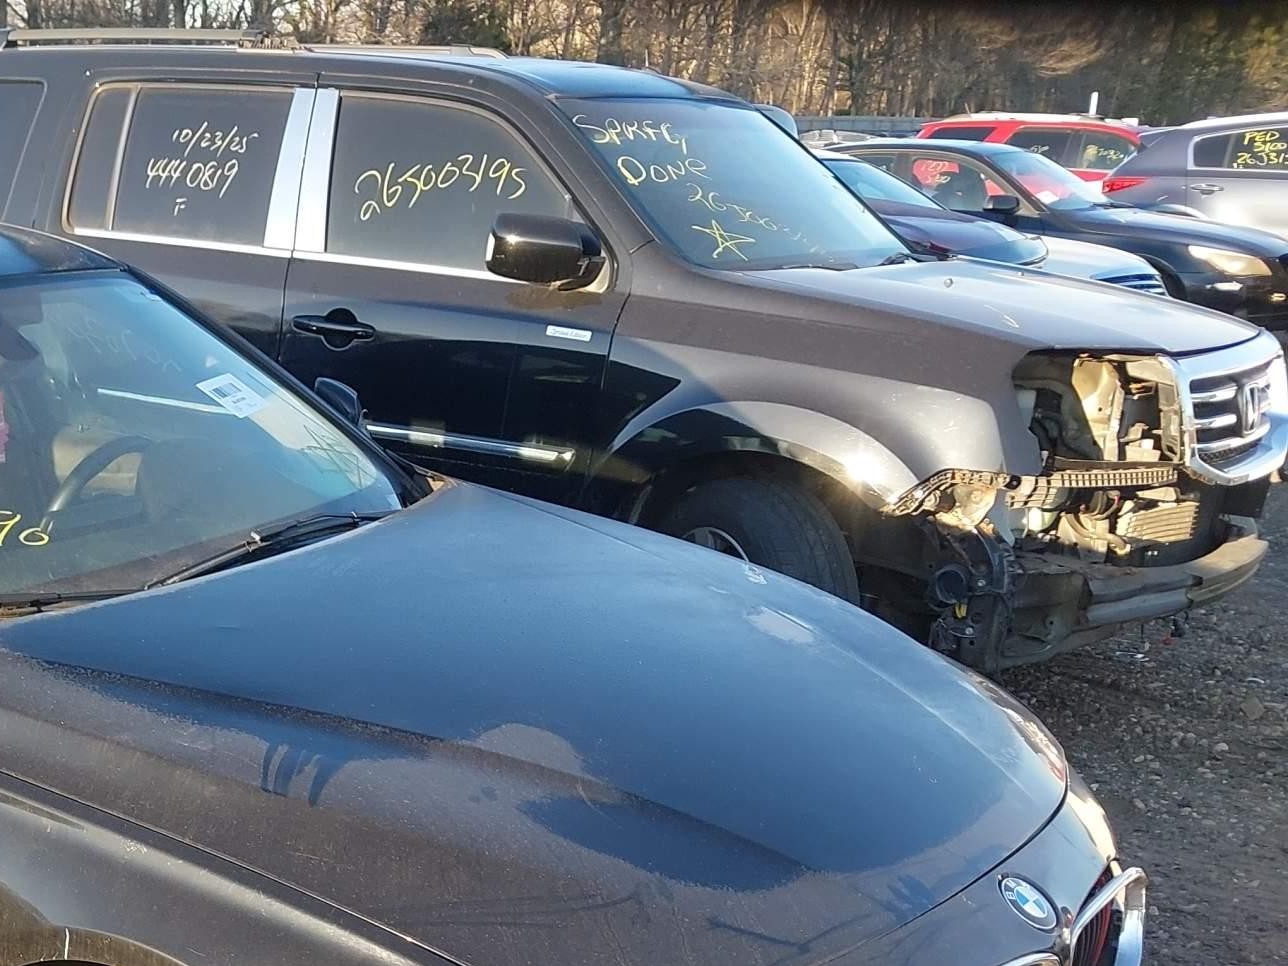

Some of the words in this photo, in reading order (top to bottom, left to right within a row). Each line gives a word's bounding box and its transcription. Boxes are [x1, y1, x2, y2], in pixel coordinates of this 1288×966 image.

[171, 121, 259, 157] 10/23/25
[1243, 131, 1281, 145] PED
[1253, 142, 1288, 154] S100
